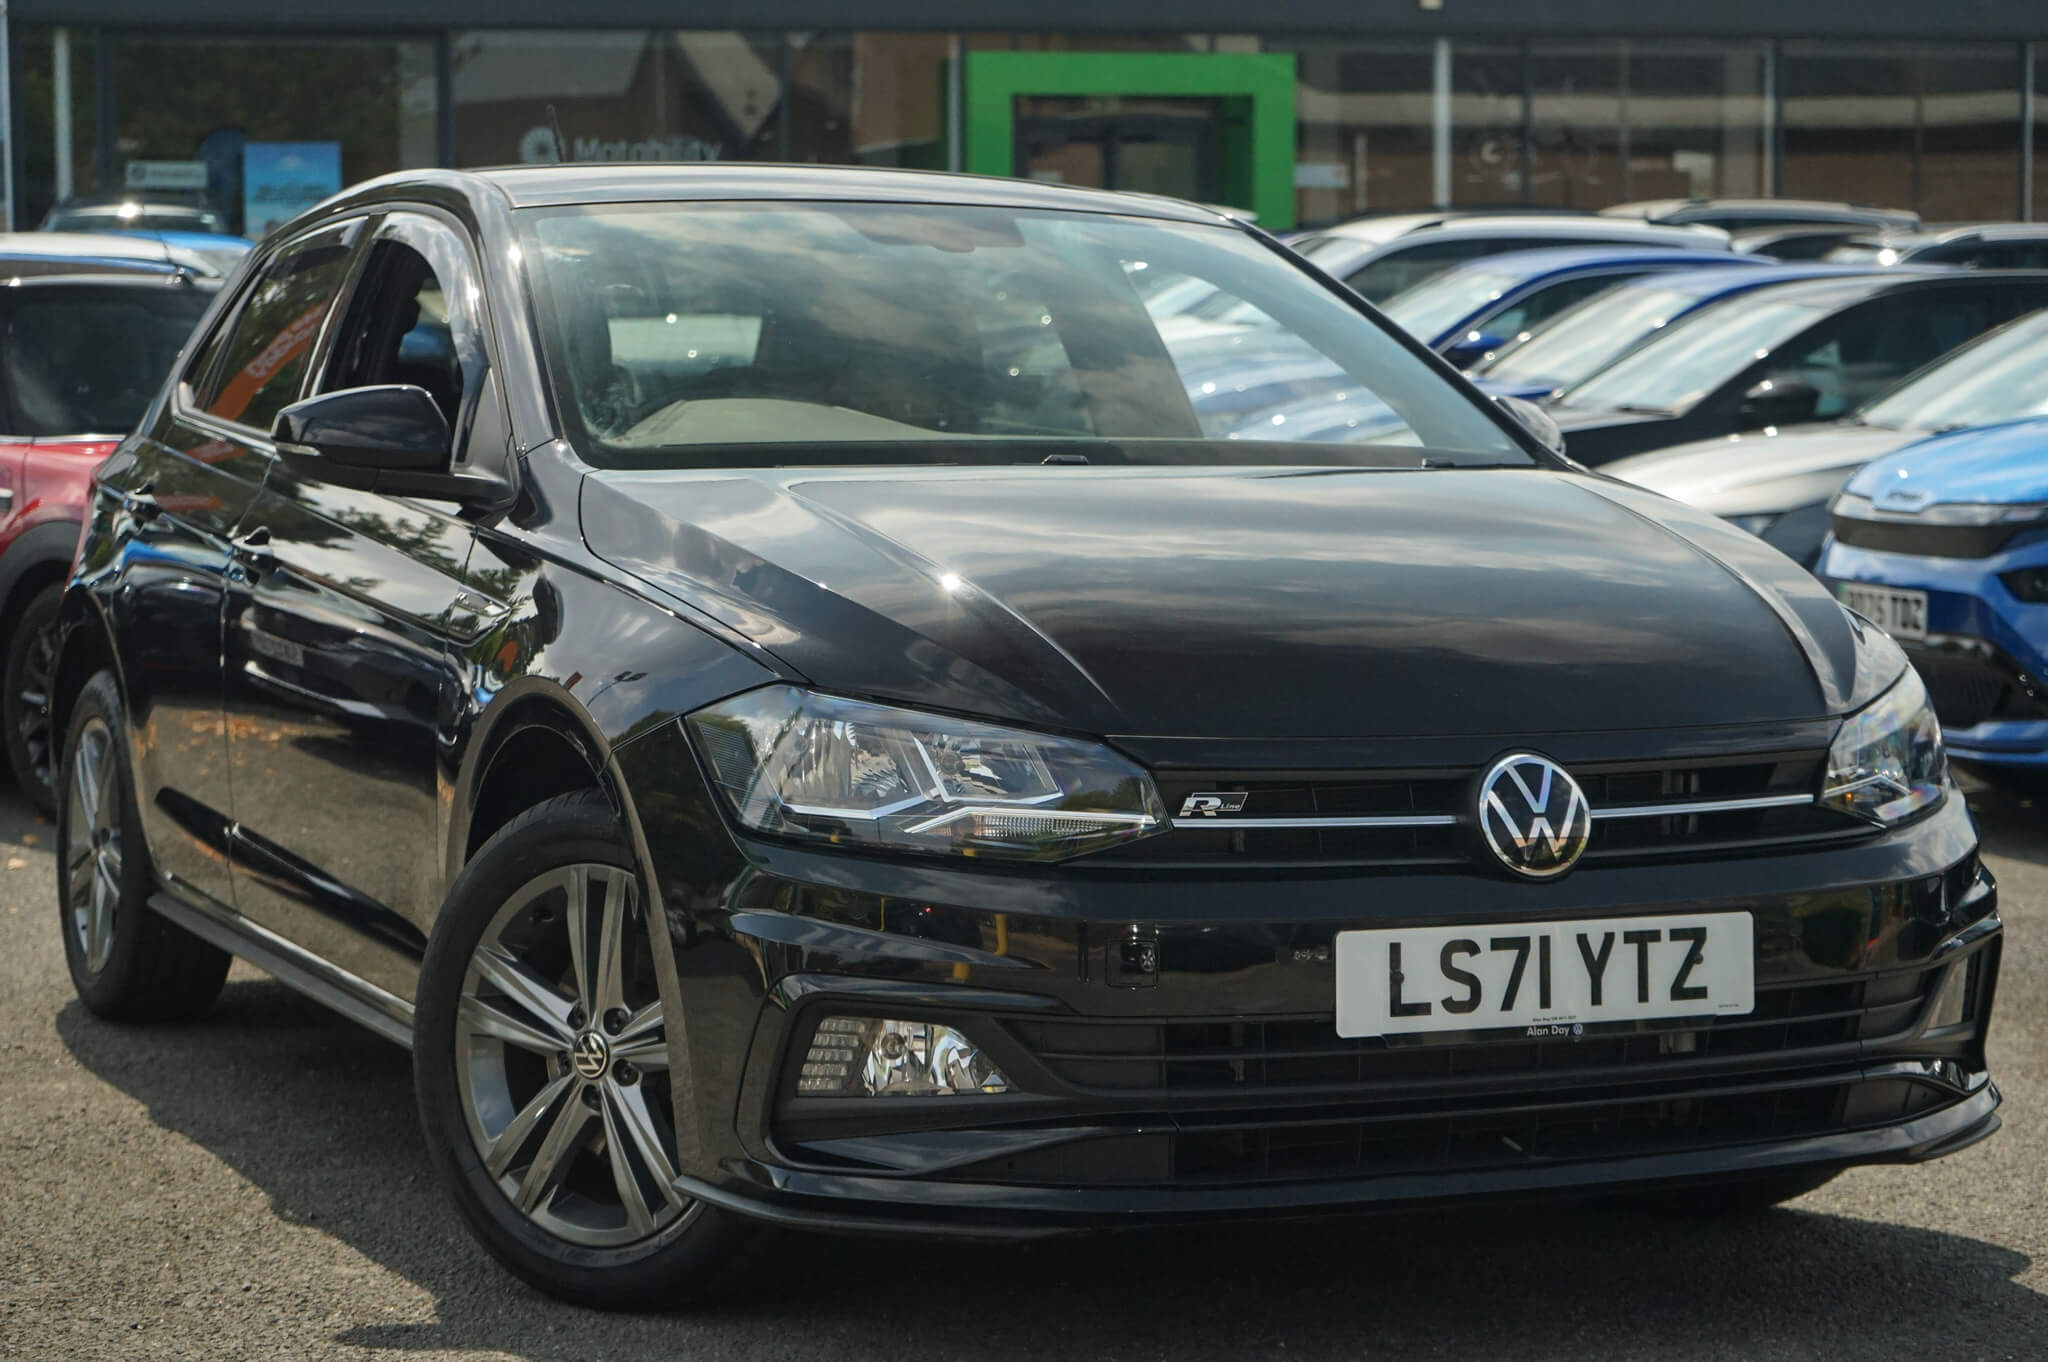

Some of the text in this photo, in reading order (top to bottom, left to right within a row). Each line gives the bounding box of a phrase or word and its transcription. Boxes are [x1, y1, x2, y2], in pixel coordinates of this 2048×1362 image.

[1389, 927, 1708, 1017] LS71 YTZ
[1527, 1026, 1549, 1037] Alan
[1552, 1025, 1570, 1037] Day
